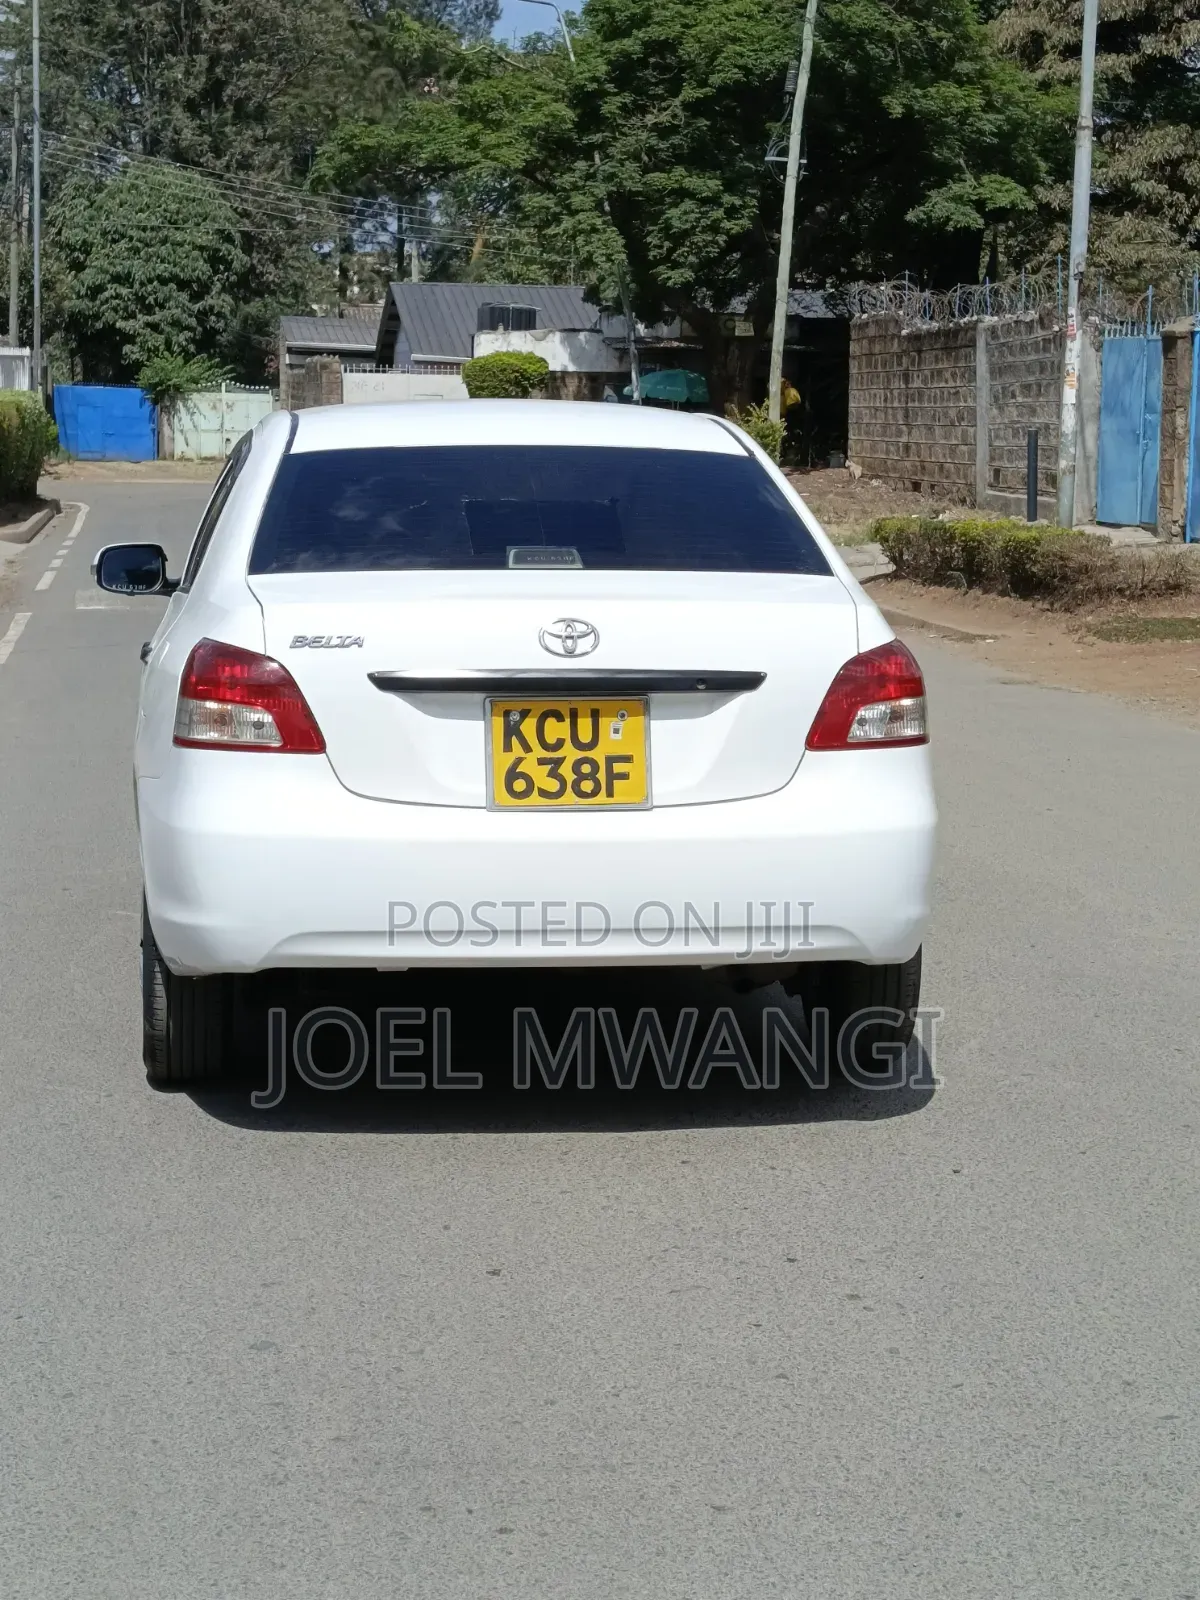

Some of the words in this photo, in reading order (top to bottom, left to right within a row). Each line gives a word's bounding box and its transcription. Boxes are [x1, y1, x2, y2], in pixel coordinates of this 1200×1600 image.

[289, 635, 364, 648] BELTA
[502, 708, 600, 754] KCU
[504, 754, 634, 801] 638F
